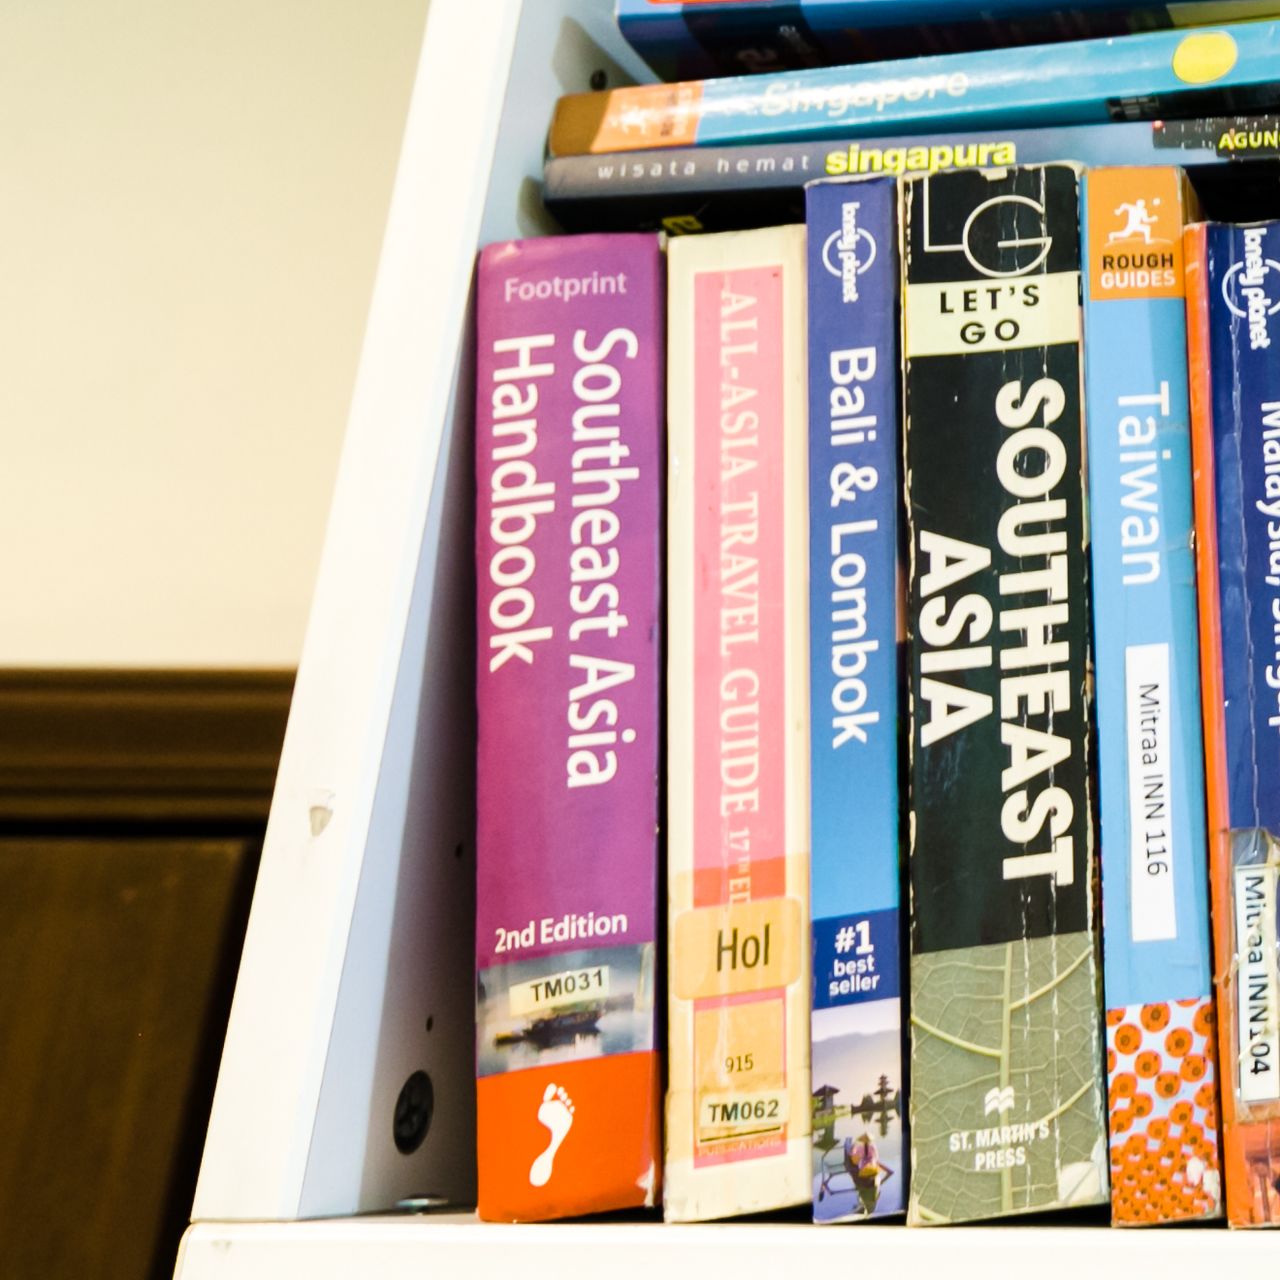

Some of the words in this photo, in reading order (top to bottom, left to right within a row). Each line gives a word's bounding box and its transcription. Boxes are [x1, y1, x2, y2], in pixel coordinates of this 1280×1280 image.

[597, 158, 696, 180] wisata
[717, 153, 811, 173] hemat
[825, 140, 1017, 176] singapura
[1100, 269, 1176, 290] GUIDES
[1101, 252, 1174, 271] ROUGH
[504, 272, 628, 303] Footprint
[939, 284, 1040, 314] LET'S
[959, 319, 1021, 345] GO
[568, 328, 640, 640] Southeast
[1117, 380, 1171, 586] Taiwan
[488, 333, 556, 674] Handbook
[919, 530, 994, 748] ASIA
[995, 377, 1074, 886] SOUTHEAST
[566, 653, 637, 790] Asia
[1138, 683, 1160, 765] Mitraa
[1143, 773, 1166, 823] INN
[1145, 830, 1168, 876] 116
[494, 919, 535, 954] 2nd
[539, 911, 628, 944] Edition
[716, 924, 770, 972] Hol
[835, 920, 874, 954] #1
[828, 972, 880, 997] seller
[833, 957, 875, 977] best
[529, 971, 604, 1003] TM031
[724, 1054, 754, 1073] 915
[708, 1098, 780, 1123] TM062
[974, 1147, 1027, 1171] PRESS
